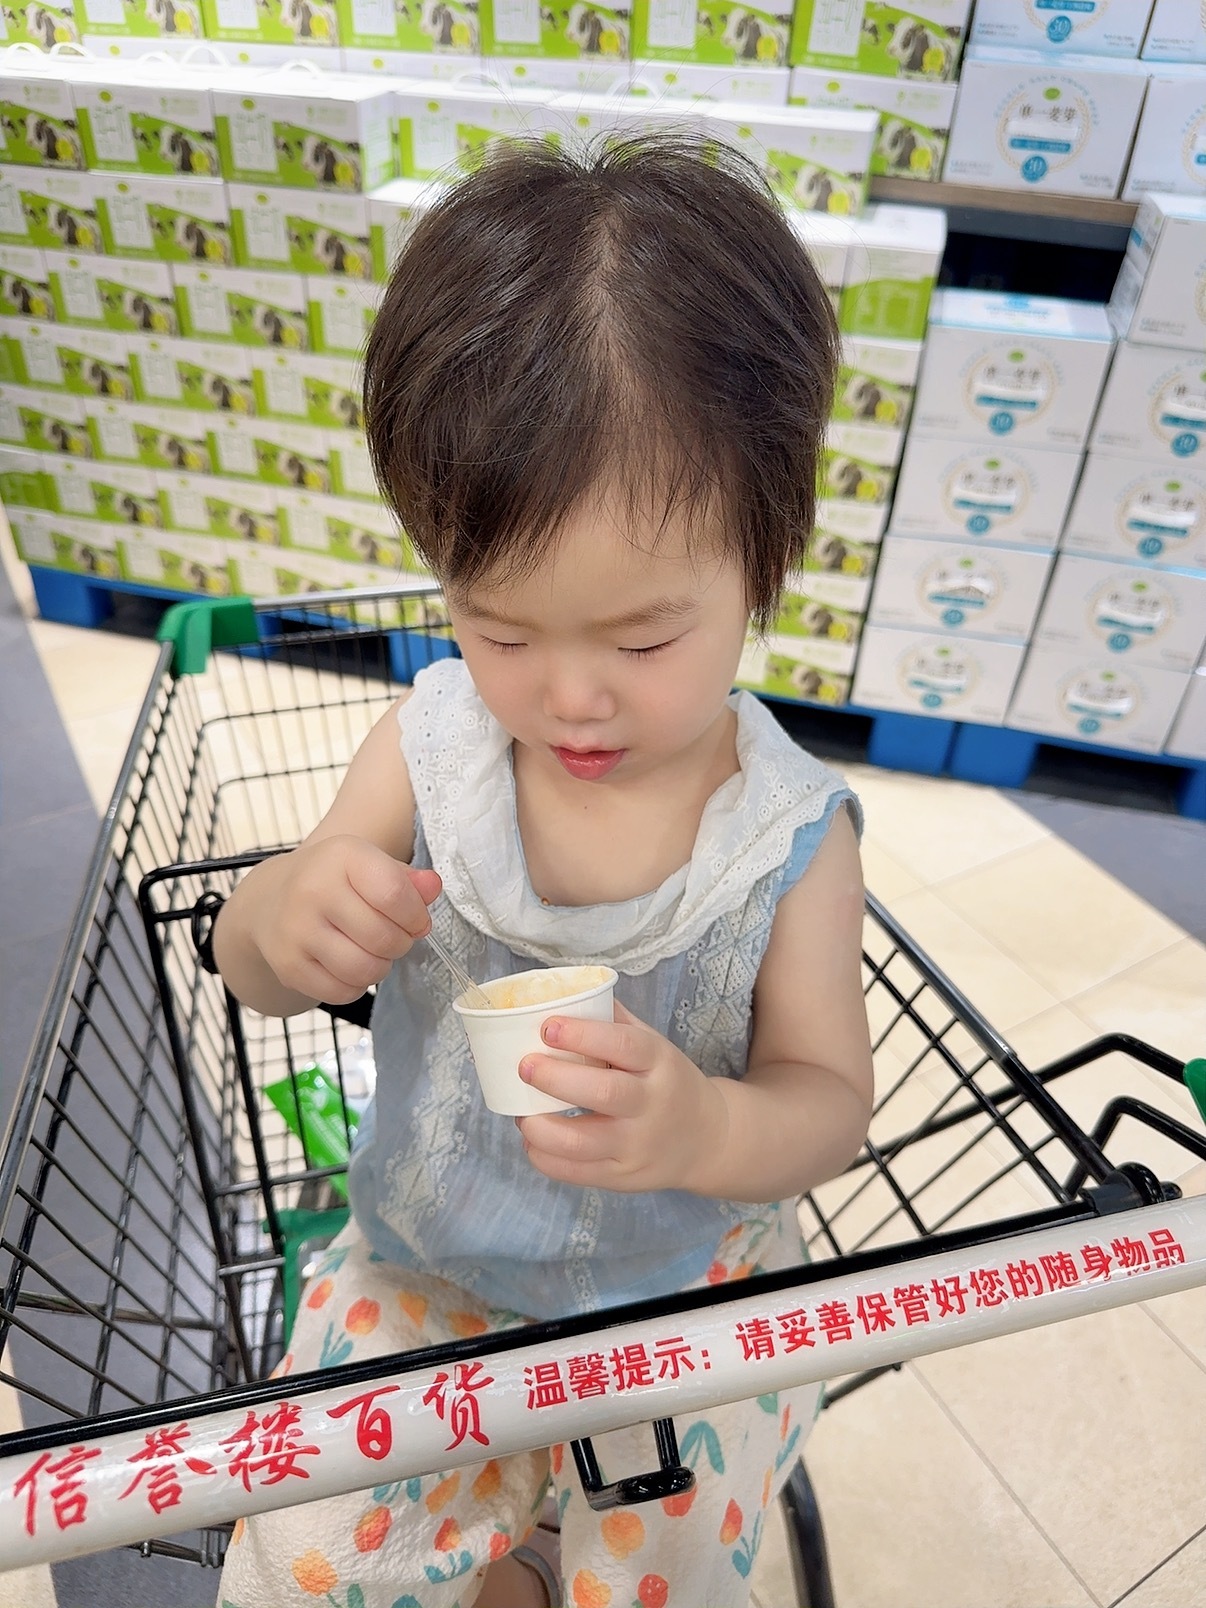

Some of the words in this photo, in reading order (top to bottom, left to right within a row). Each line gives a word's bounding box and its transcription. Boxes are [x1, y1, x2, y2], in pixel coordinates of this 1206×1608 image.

[736, 1229, 1185, 1361] 请妥善保管好您的随身物品
[14, 1361, 495, 1537] 信誉楼百货
